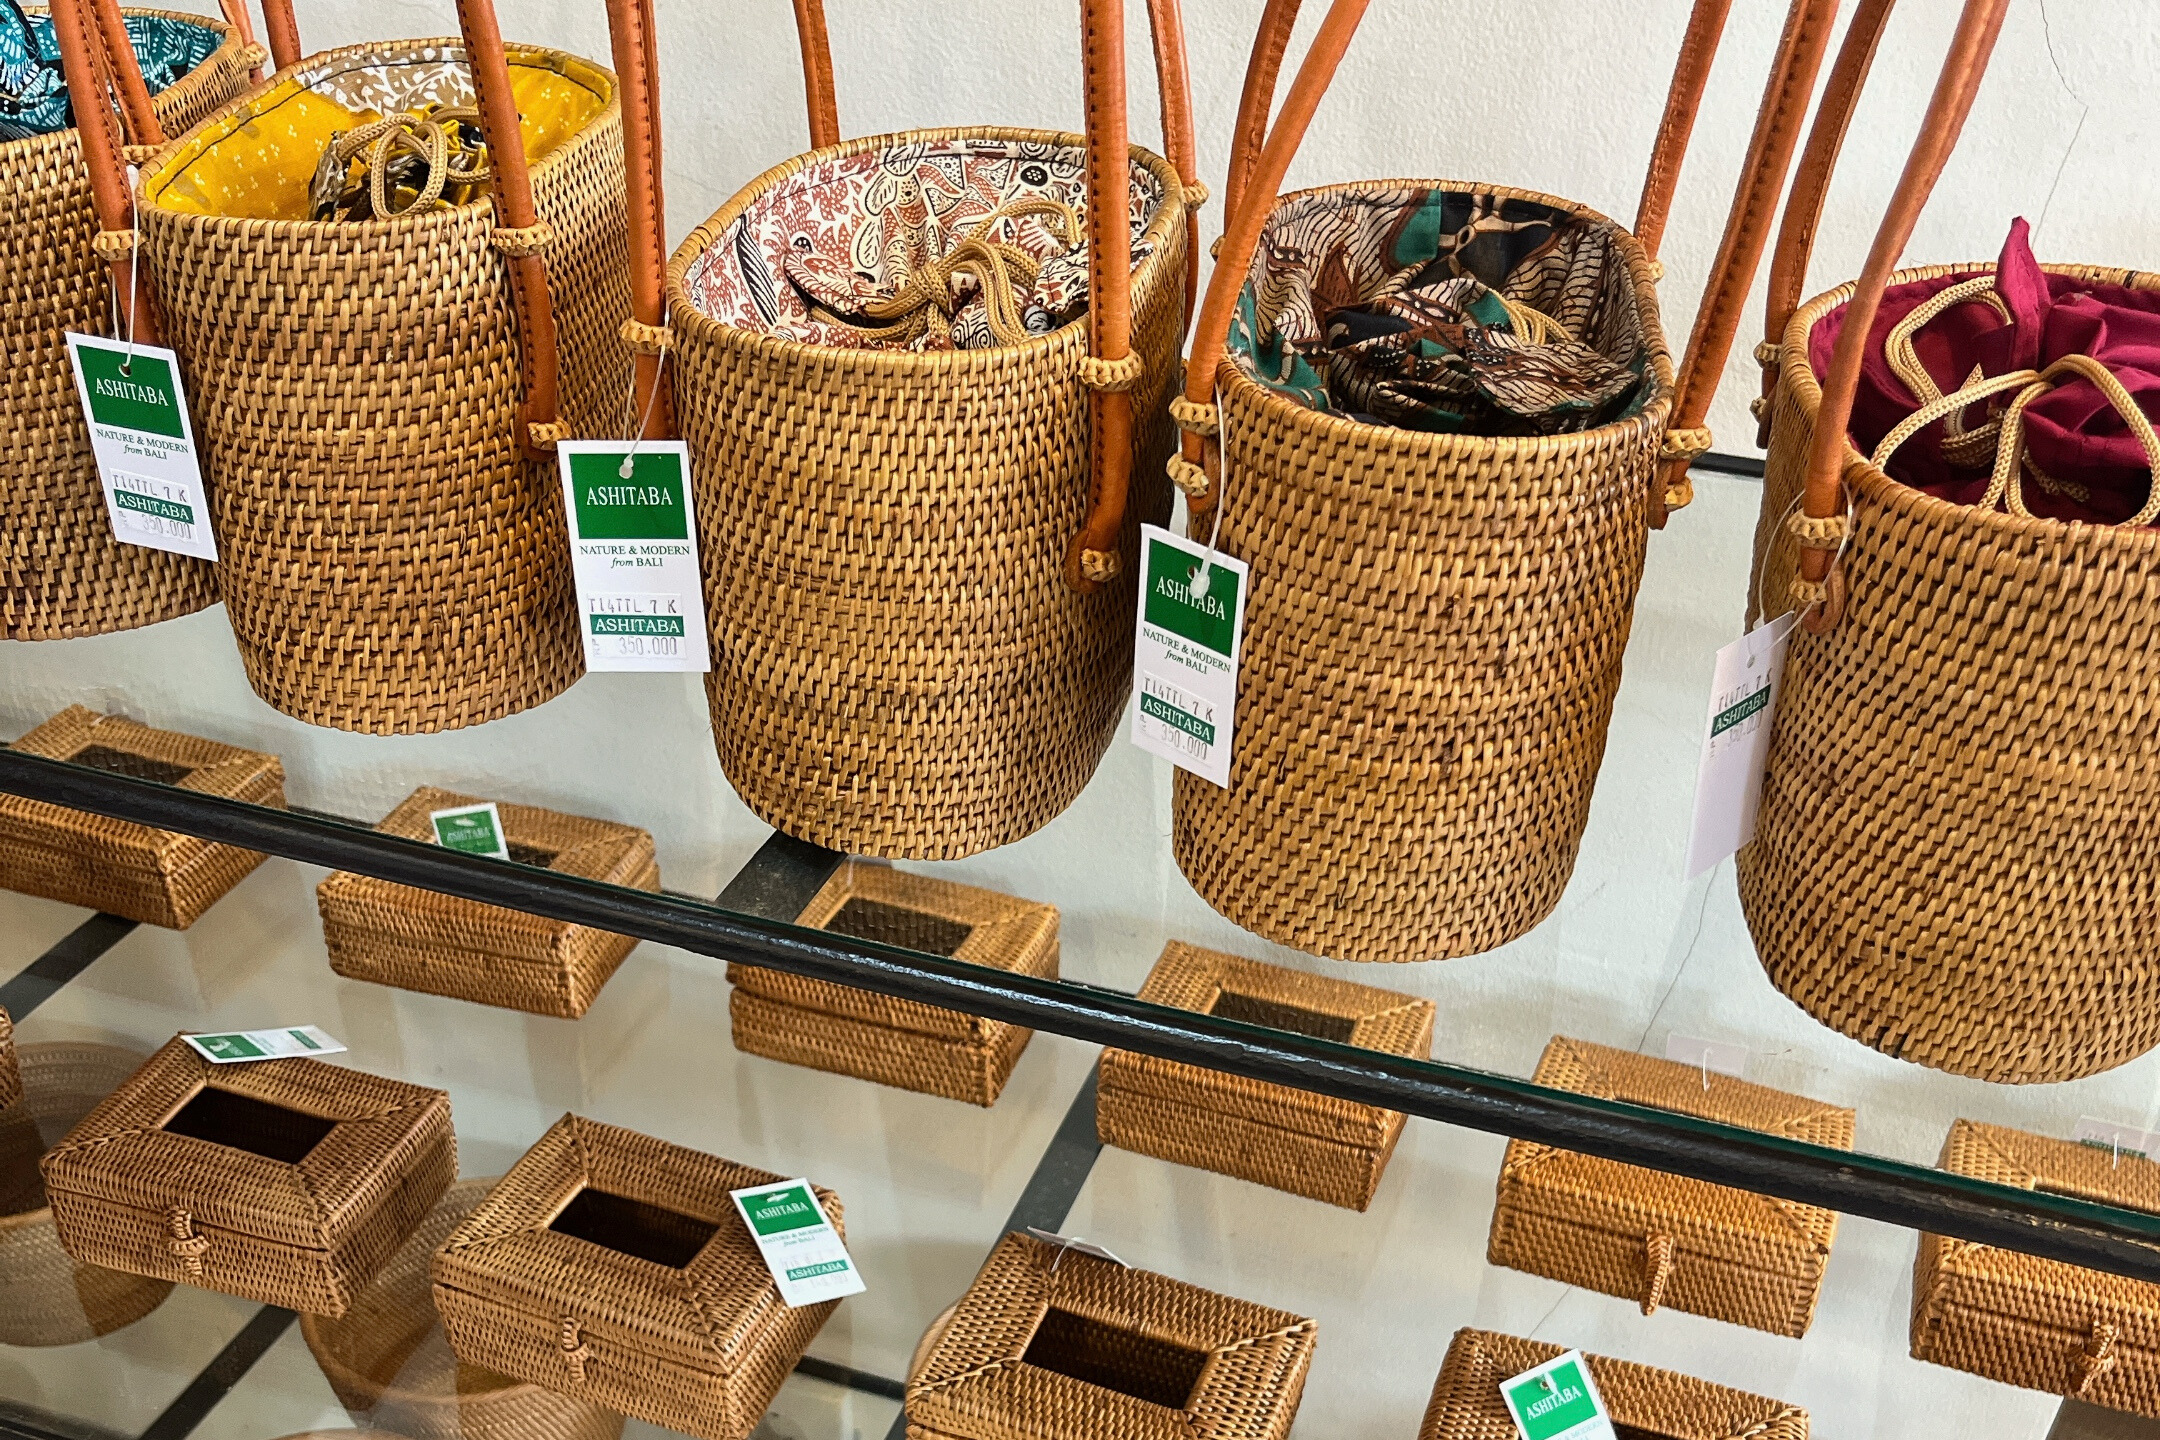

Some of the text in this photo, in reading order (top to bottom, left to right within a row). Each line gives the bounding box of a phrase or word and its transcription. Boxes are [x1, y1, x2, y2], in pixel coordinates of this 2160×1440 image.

[96, 378, 169, 407] ASHITABA
[96, 429, 188, 453] NATURE & MODERN
[123, 444, 167, 460] from BALI
[179, 489, 187, 502] K
[587, 487, 673, 505] ASHITABA
[118, 493, 189, 520] ASHITABA
[579, 546, 690, 555] NATURE & MODERN
[611, 558, 663, 568] from BALI
[668, 600, 676, 613] K
[595, 618, 680, 633] ASHITABA
[619, 637, 677, 655] 350.000
[1143, 628, 1231, 673] NATURE & MODERN
[1164, 650, 1208, 674] from BALI
[1144, 698, 1211, 741] ASHITABA
[1205, 707, 1213, 722] K
[1714, 691, 1766, 733] ASHITABA
[755, 1202, 809, 1220] ASHITABA
[790, 1262, 844, 1279] ASHITABA
[1526, 1385, 1582, 1421] ASHITABA
